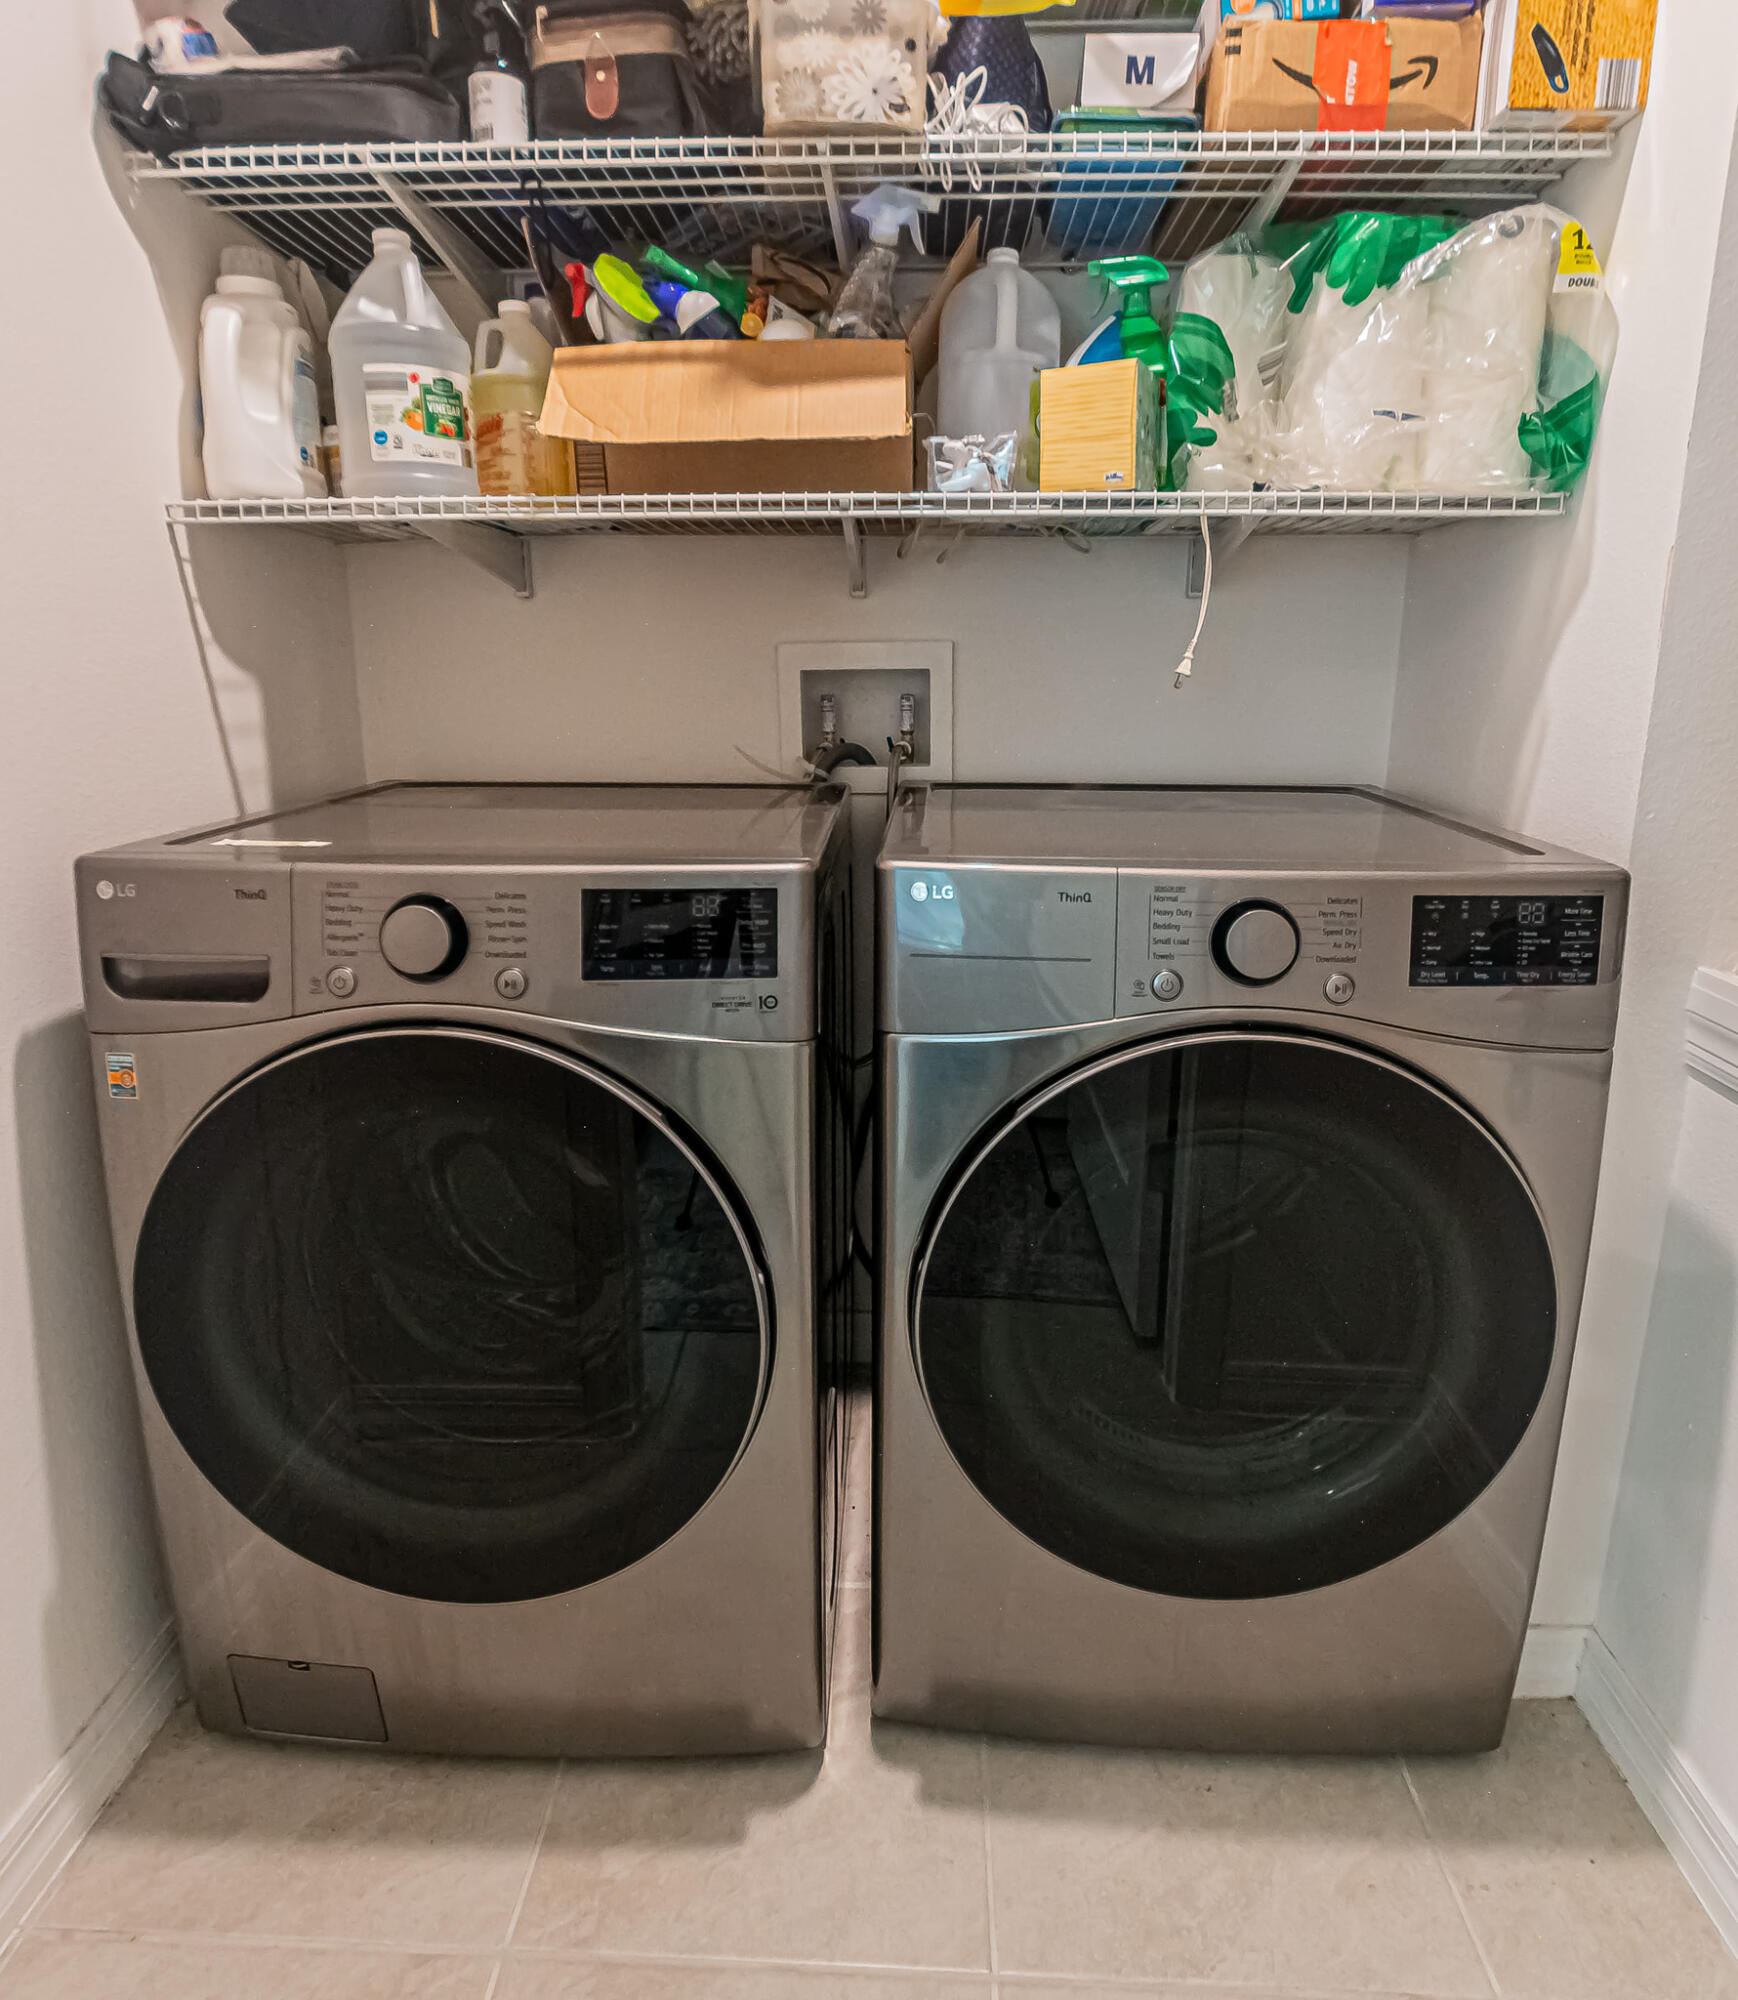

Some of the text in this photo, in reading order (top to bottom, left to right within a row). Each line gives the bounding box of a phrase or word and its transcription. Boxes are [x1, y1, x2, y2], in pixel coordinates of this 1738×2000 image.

[1126, 56, 1155, 85] M
[1572, 228, 1593, 250] 1
[427, 401, 461, 417] VINEGAR
[117, 884, 137, 897] LG
[234, 889, 267, 900] ThinQ
[932, 885, 954, 900] LG
[1058, 892, 1092, 903] ThinQ
[1152, 909, 1193, 918] Heavy Duty
